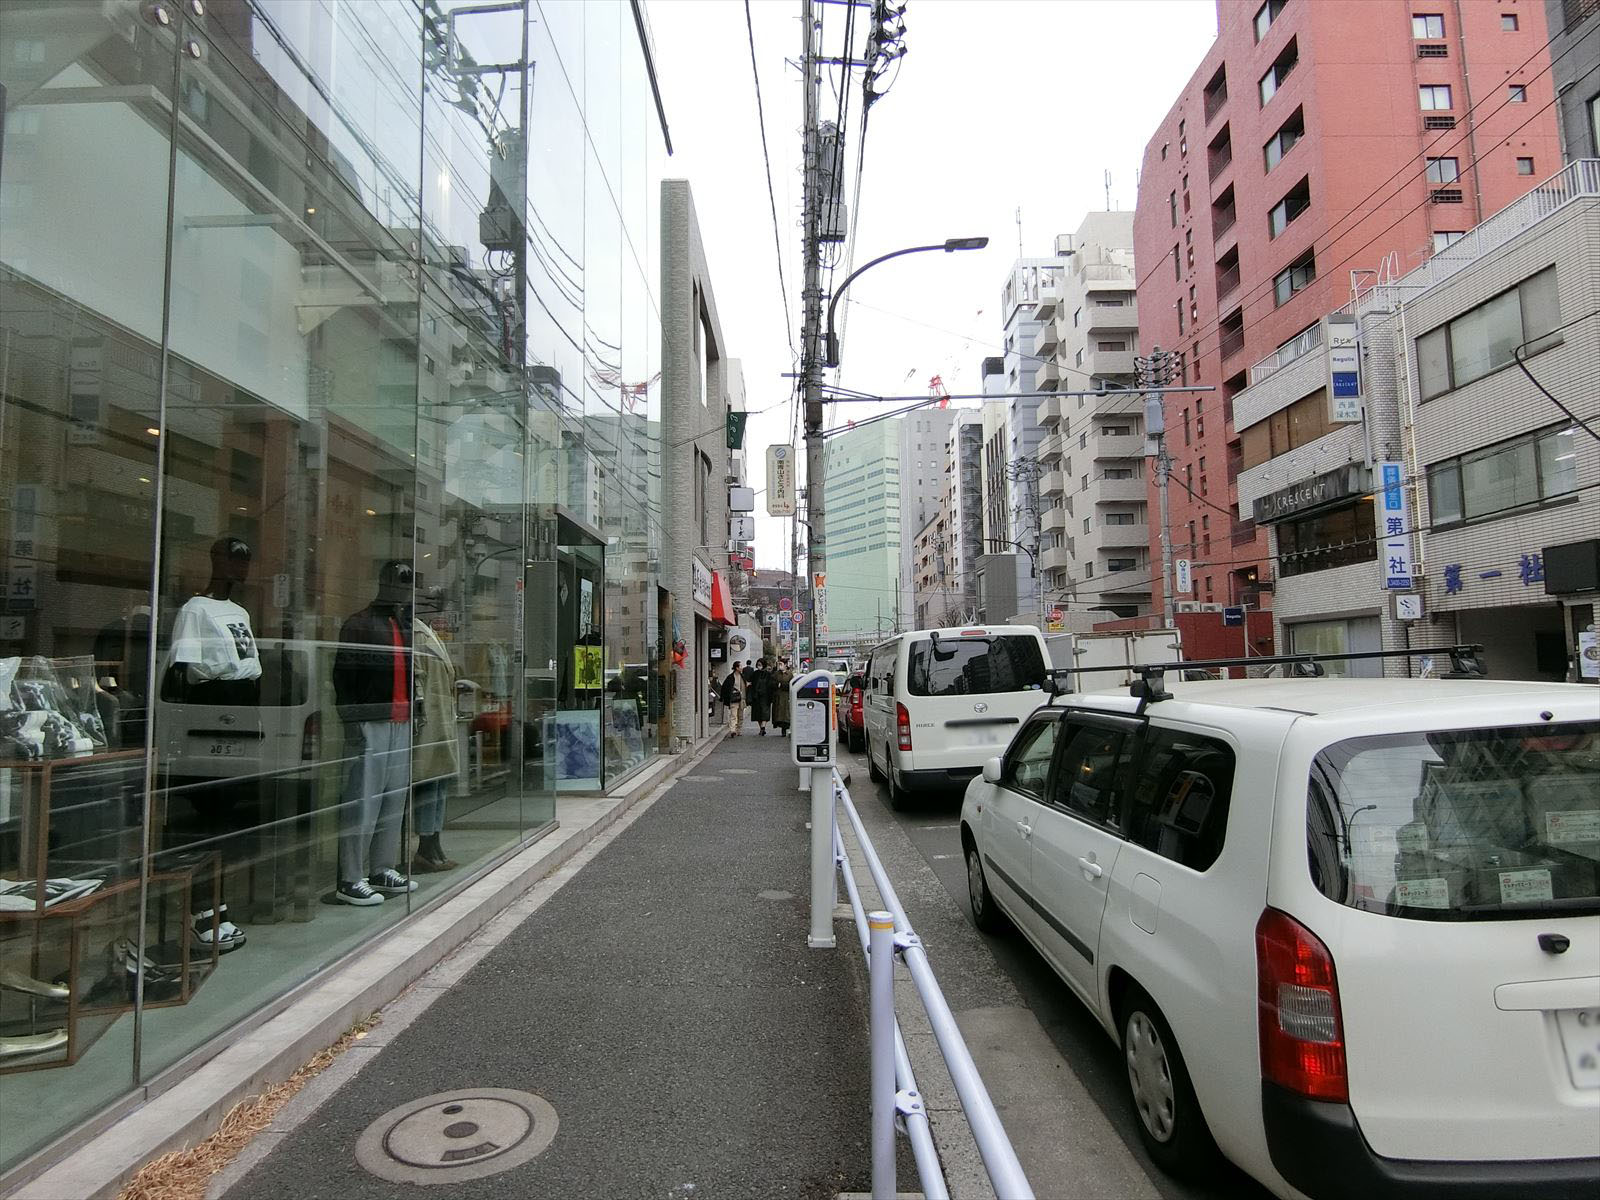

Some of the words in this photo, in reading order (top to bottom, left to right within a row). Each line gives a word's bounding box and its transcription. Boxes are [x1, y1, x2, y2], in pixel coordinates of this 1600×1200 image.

[1277, 483, 1326, 509] CRESCENT
[1387, 517, 1407, 574] 第一社
[1444, 553, 1545, 596] 第一社
